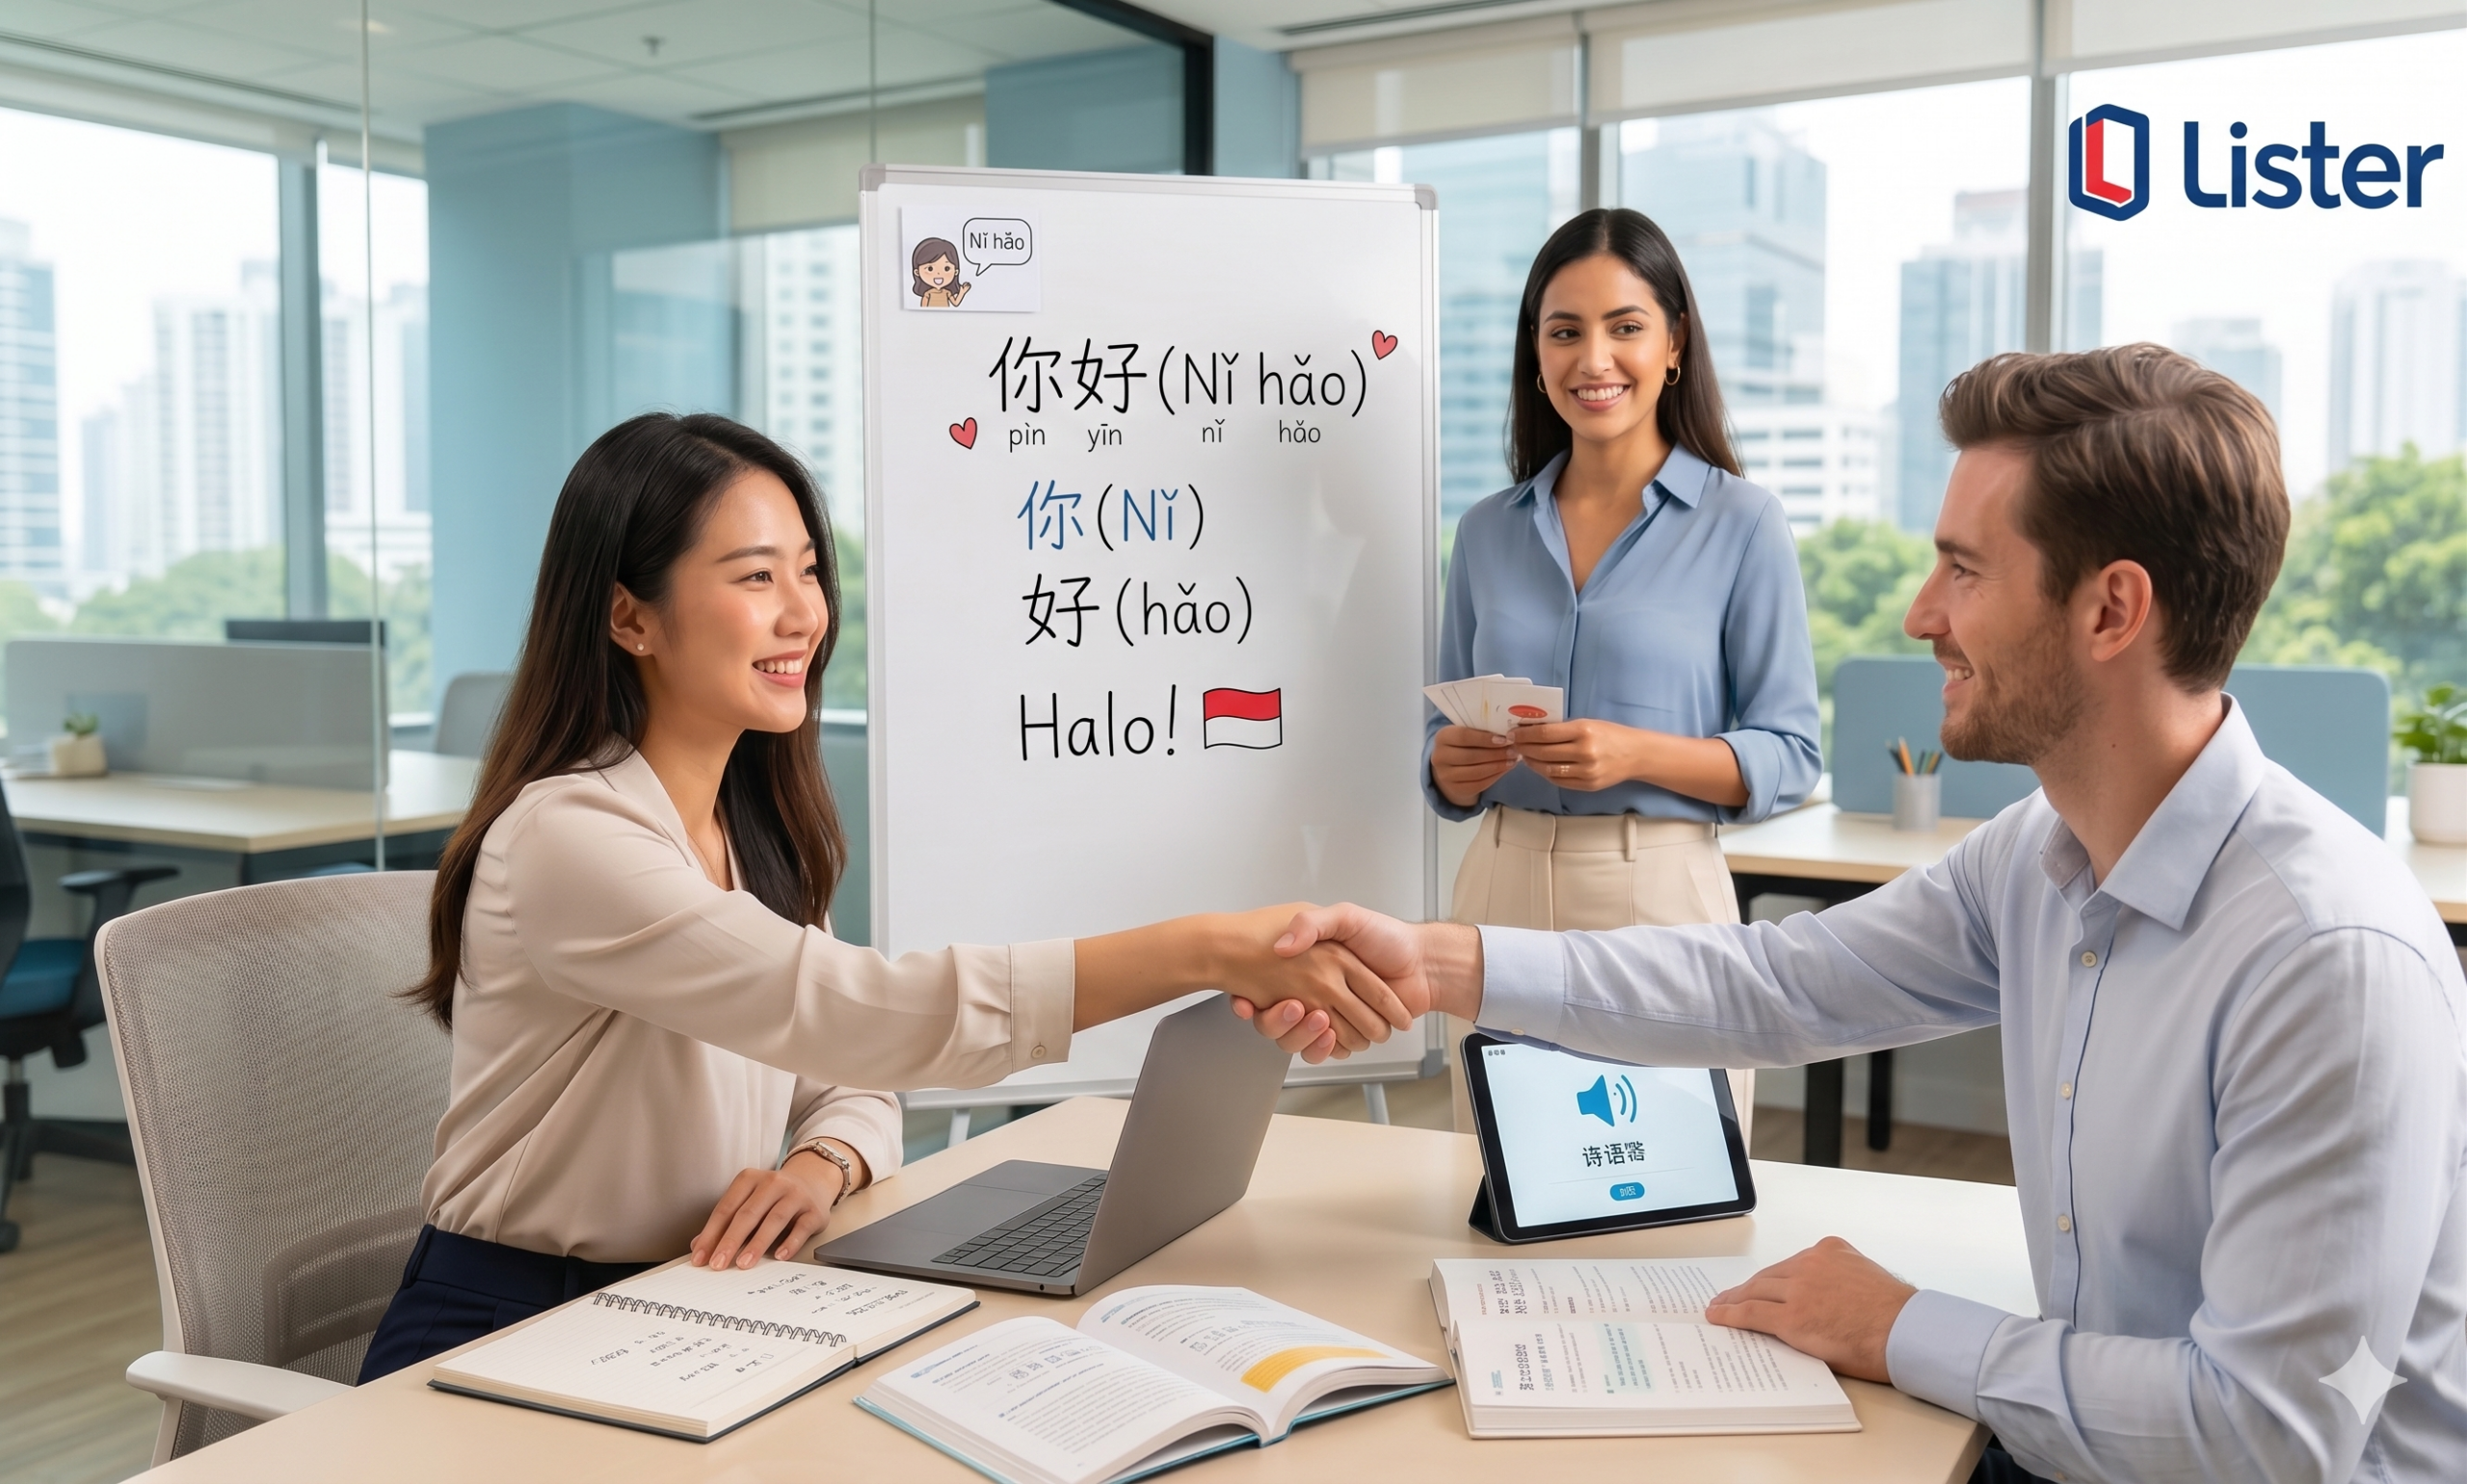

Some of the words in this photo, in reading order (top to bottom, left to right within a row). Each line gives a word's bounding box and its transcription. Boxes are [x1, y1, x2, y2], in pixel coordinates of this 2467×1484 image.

[1009, 421, 1046, 454] pìn
[1087, 423, 1123, 453] yīn
[1202, 418, 1226, 443] nǐ
[1279, 419, 1321, 443] hǎo
[1020, 683, 1177, 762] Halo!
